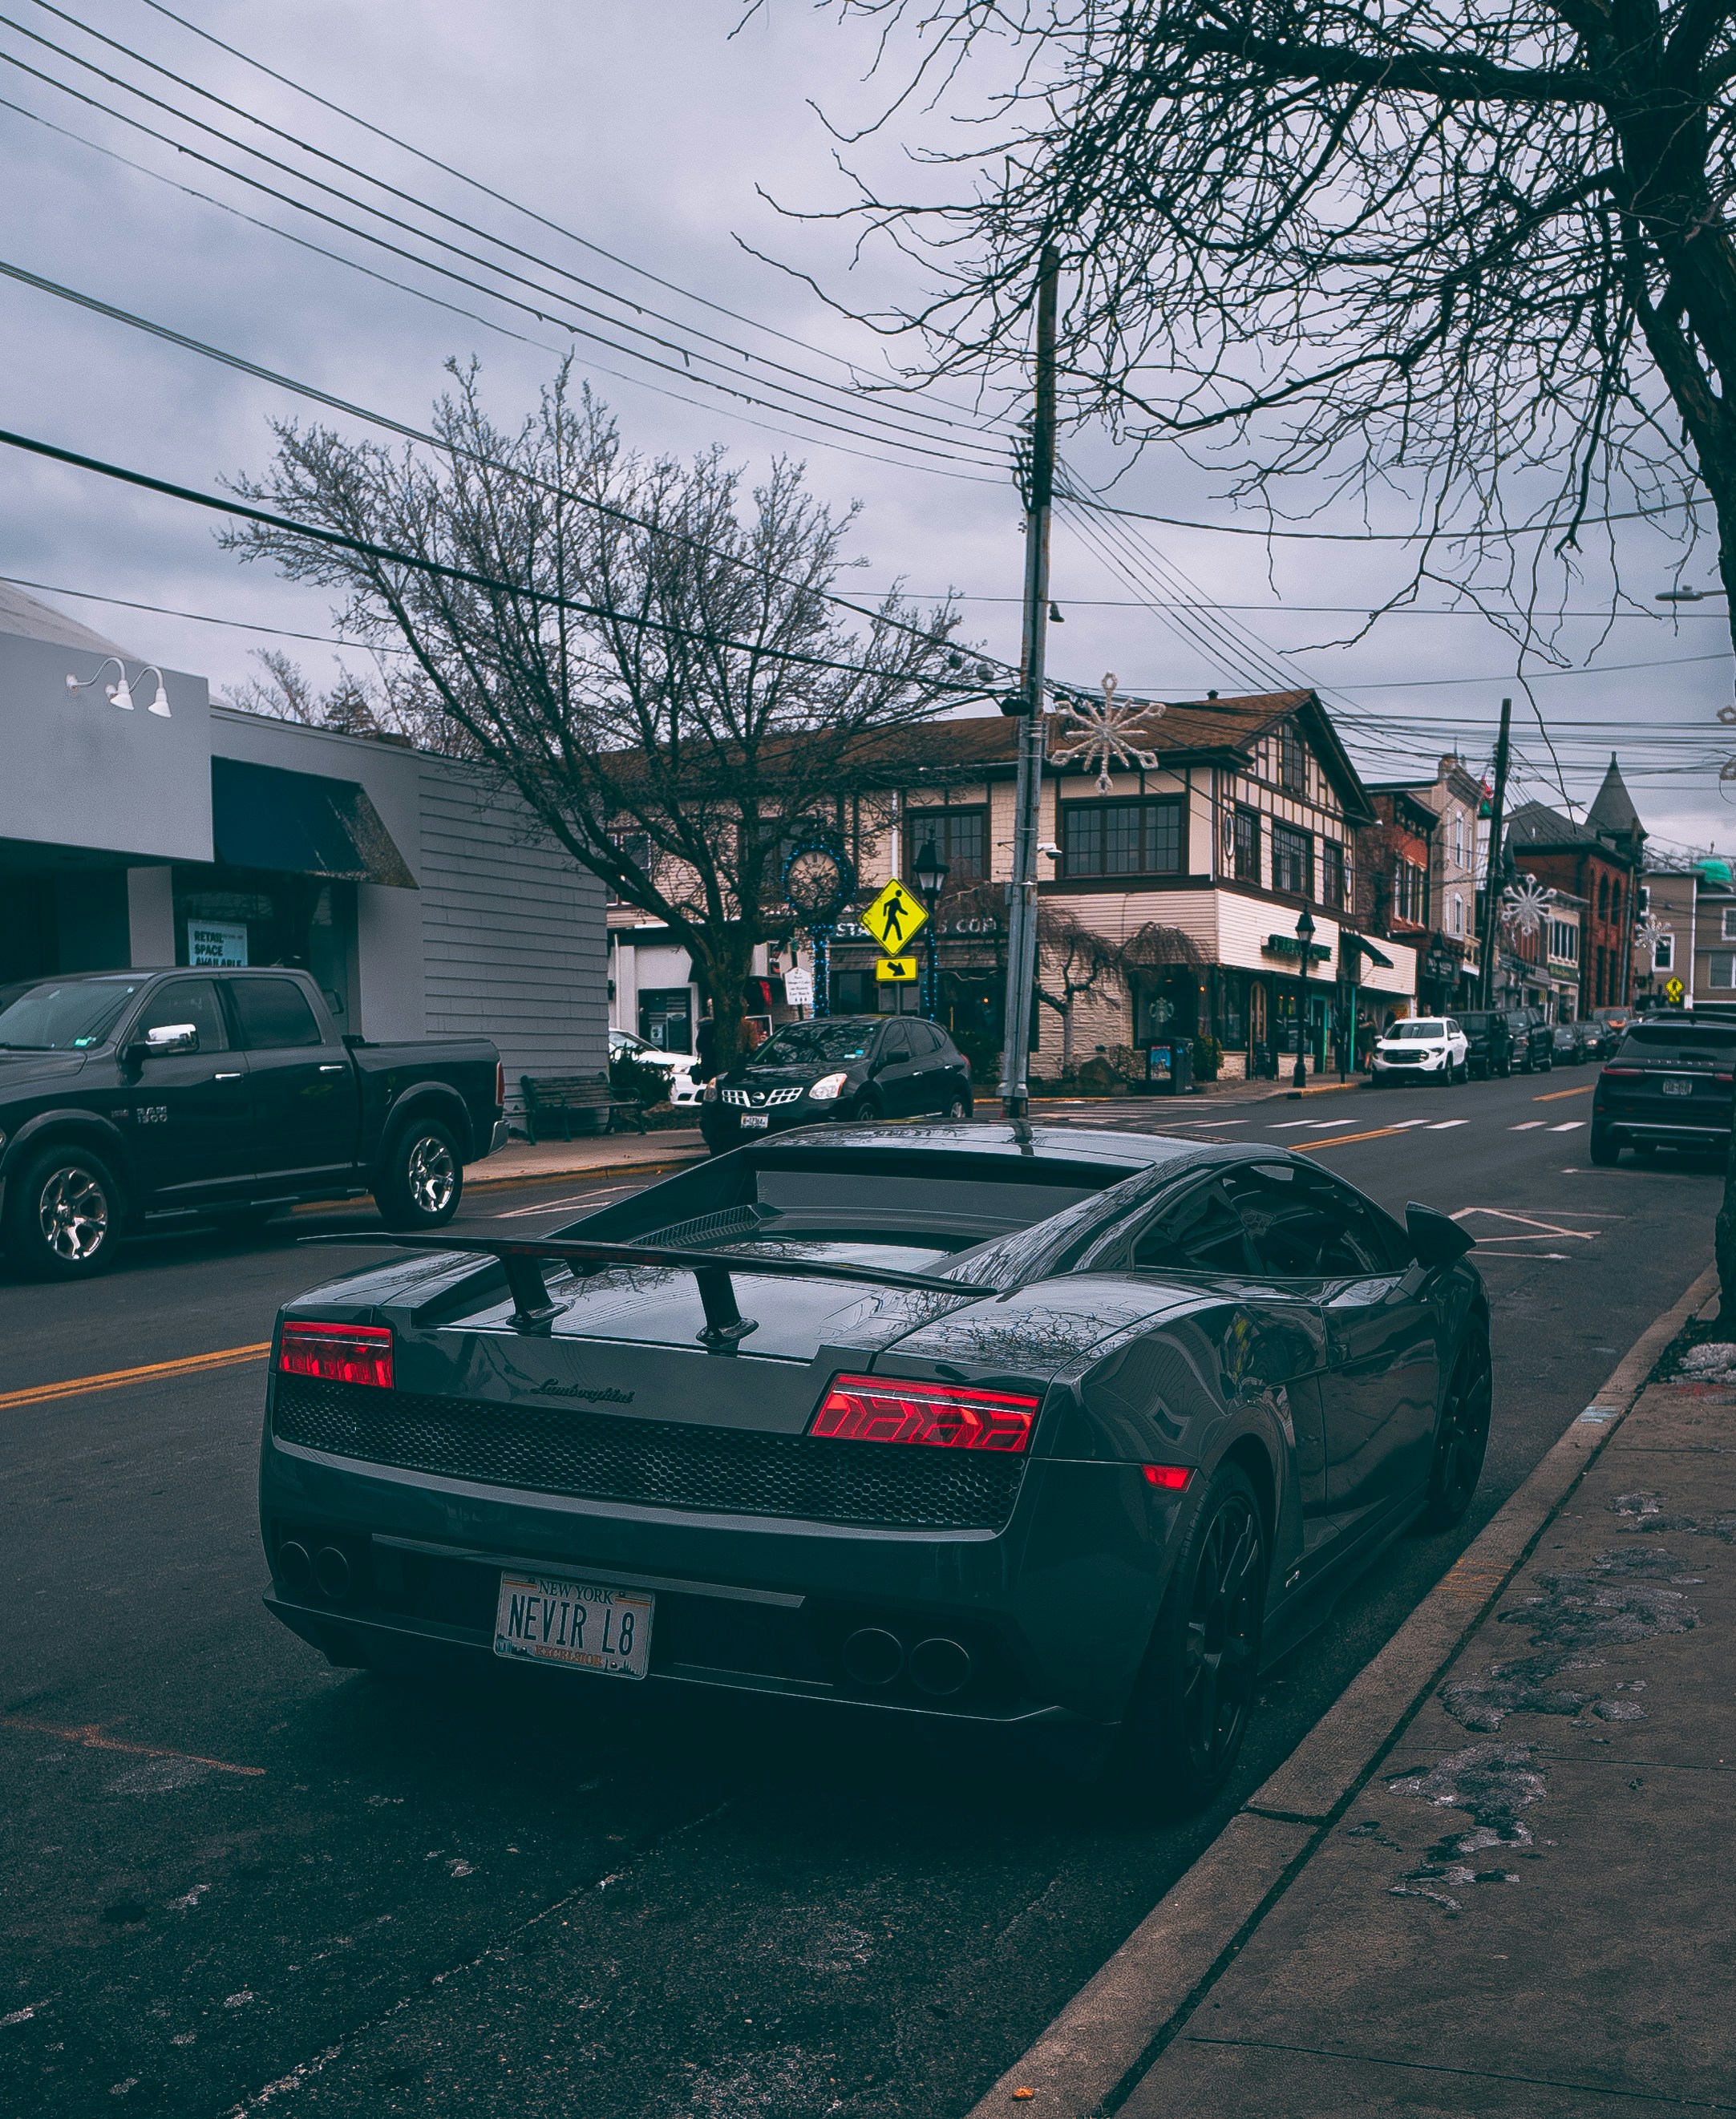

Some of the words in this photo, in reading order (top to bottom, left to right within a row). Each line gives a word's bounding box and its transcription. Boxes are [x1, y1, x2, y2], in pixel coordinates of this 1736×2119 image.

[195, 931, 224, 943] RETAIL
[195, 944, 223, 956] SPACE
[530, 1378, 635, 1403] Lamborghini
[539, 1580, 573, 1599] NEW
[577, 1584, 613, 1605] YORK
[508, 1593, 587, 1649] NEVIR
[602, 1608, 635, 1656] L8
[535, 1644, 602, 1668] EXCELSIOR
